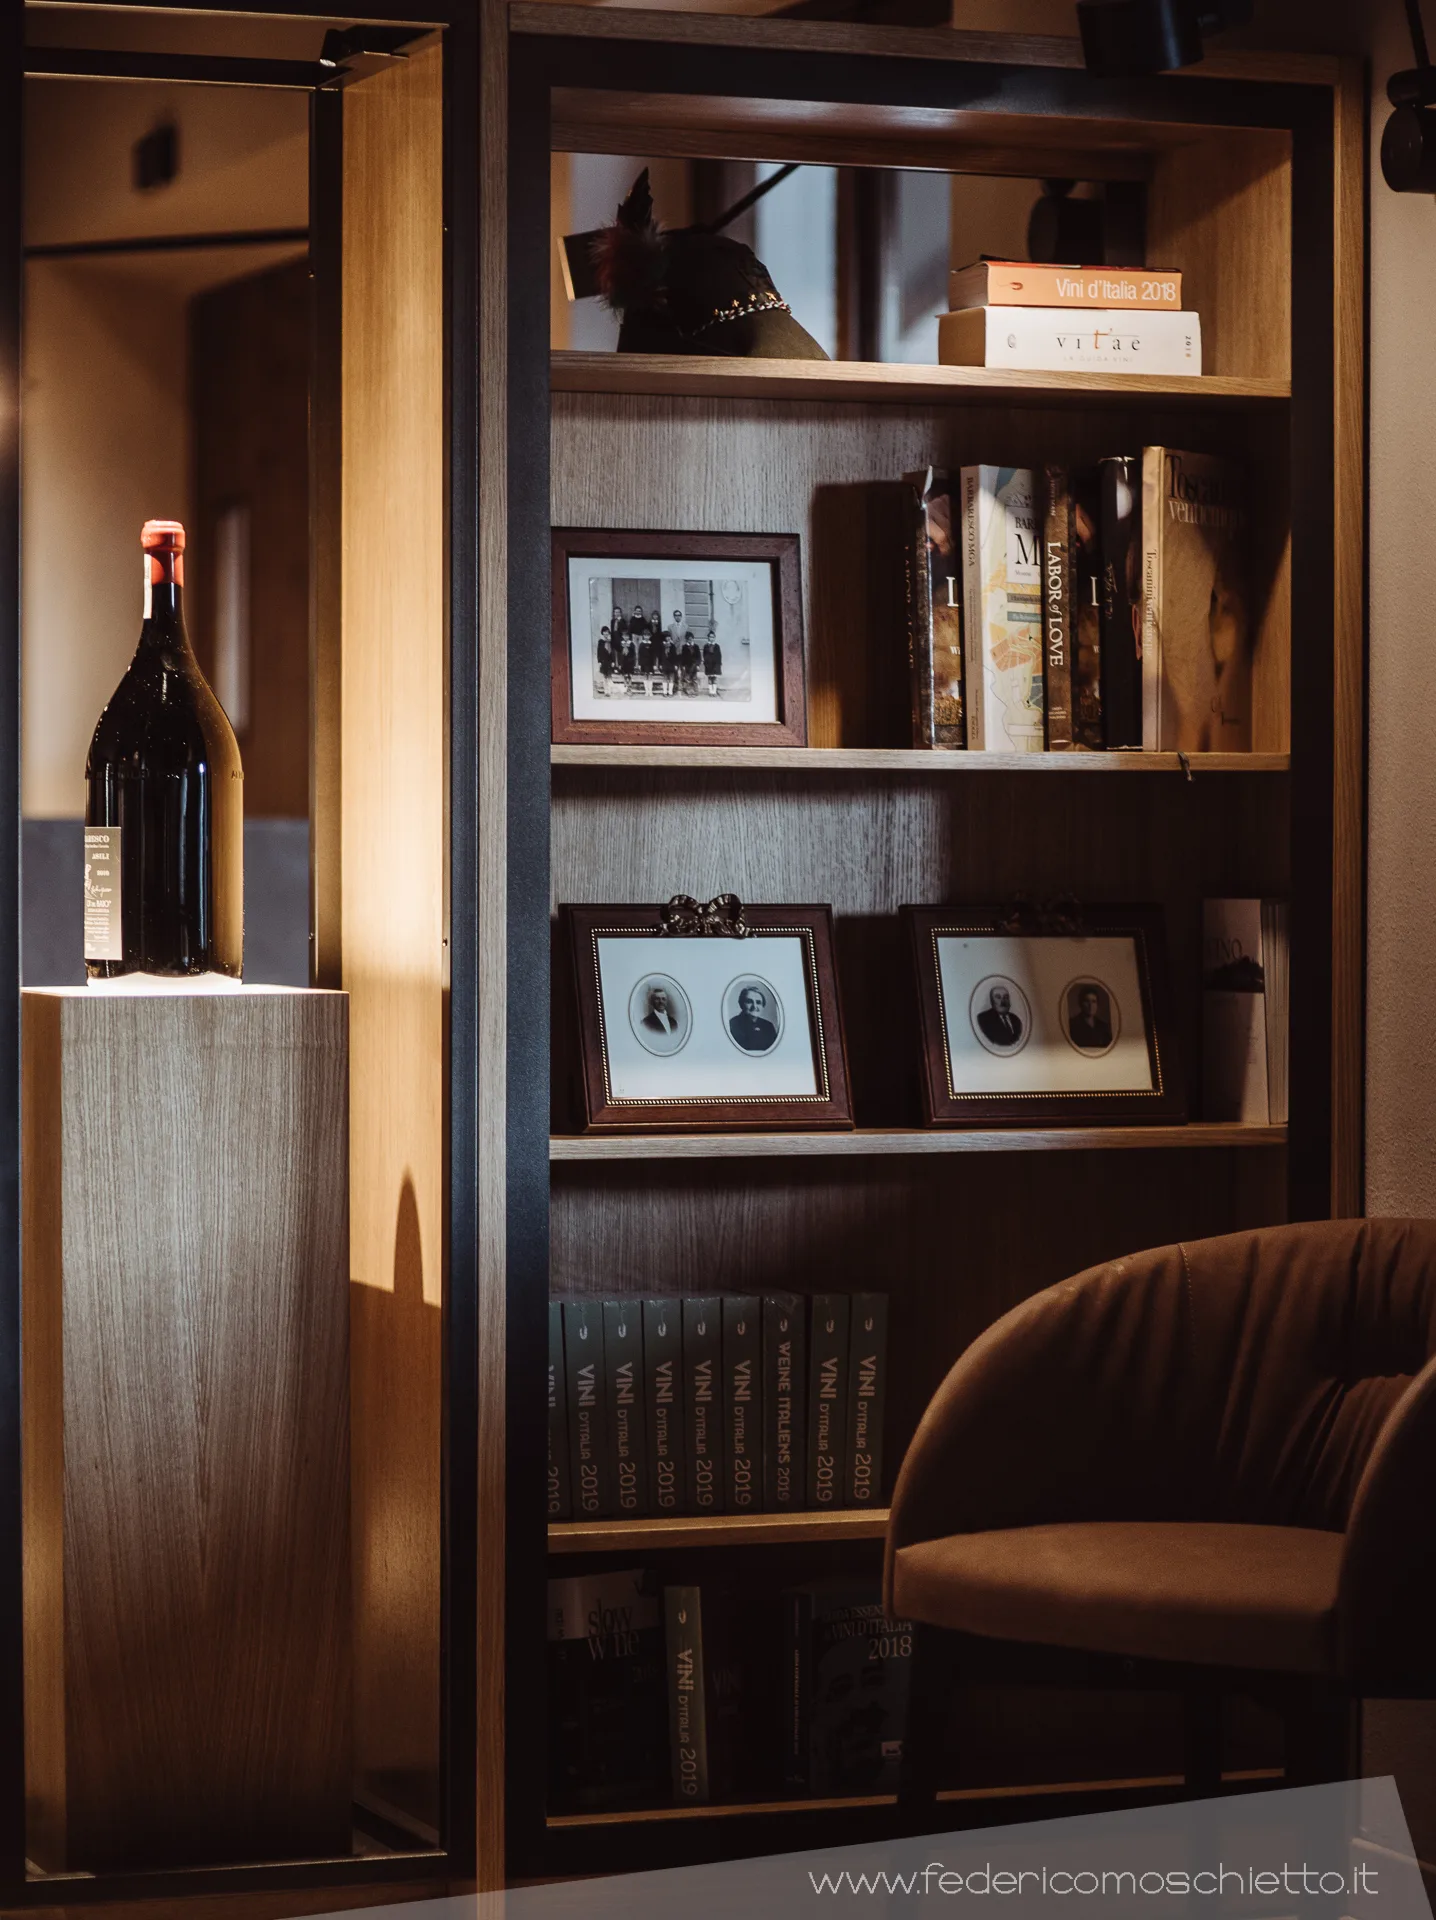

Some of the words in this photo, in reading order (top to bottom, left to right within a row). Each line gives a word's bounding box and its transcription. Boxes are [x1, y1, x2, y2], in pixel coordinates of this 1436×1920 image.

[1056, 278, 1084, 298] Vini
[1088, 280, 1137, 300] d'Italia
[1141, 281, 1176, 301] 2018
[1056, 327, 1141, 351] vitae
[966, 477, 976, 542] BARBARESCO
[967, 543, 976, 567] MGA
[1047, 541, 1062, 602] LABOR
[1049, 602, 1062, 615] of
[1048, 617, 1064, 667] LOVE
[577, 1364, 596, 1407] VINI
[616, 1361, 634, 1405] VINI
[655, 1361, 673, 1403] VINI
[695, 1359, 712, 1402] VINI
[734, 1359, 751, 1401] VINI
[777, 1340, 791, 1392] WEINE
[820, 1357, 838, 1399] VINI
[858, 1355, 877, 1397] VINI
[578, 1411, 591, 1460] D'ITALIA
[617, 1409, 629, 1458] D'ITALIA
[656, 1408, 668, 1456] D'ITALIA
[695, 1406, 706, 1455] D'ITALIA
[734, 1406, 744, 1455] D'ITALIA
[777, 1396, 791, 1464] ITALIENS
[818, 1403, 829, 1451] D'ITALIA
[856, 1401, 868, 1449] D'ITALIA
[581, 1464, 598, 1511] 2019
[619, 1462, 637, 1509] 2019
[657, 1461, 675, 1508] 2019
[696, 1459, 713, 1506] 2019
[734, 1459, 751, 1506] 2019
[777, 1467, 790, 1501] 2019
[816, 1456, 834, 1502] 2019
[854, 1453, 872, 1500] 2019
[676, 1648, 694, 1691] VINI
[868, 1635, 913, 1661] 2018
[678, 1695, 690, 1743] D'ITALIA
[679, 1749, 698, 1796] 2019
